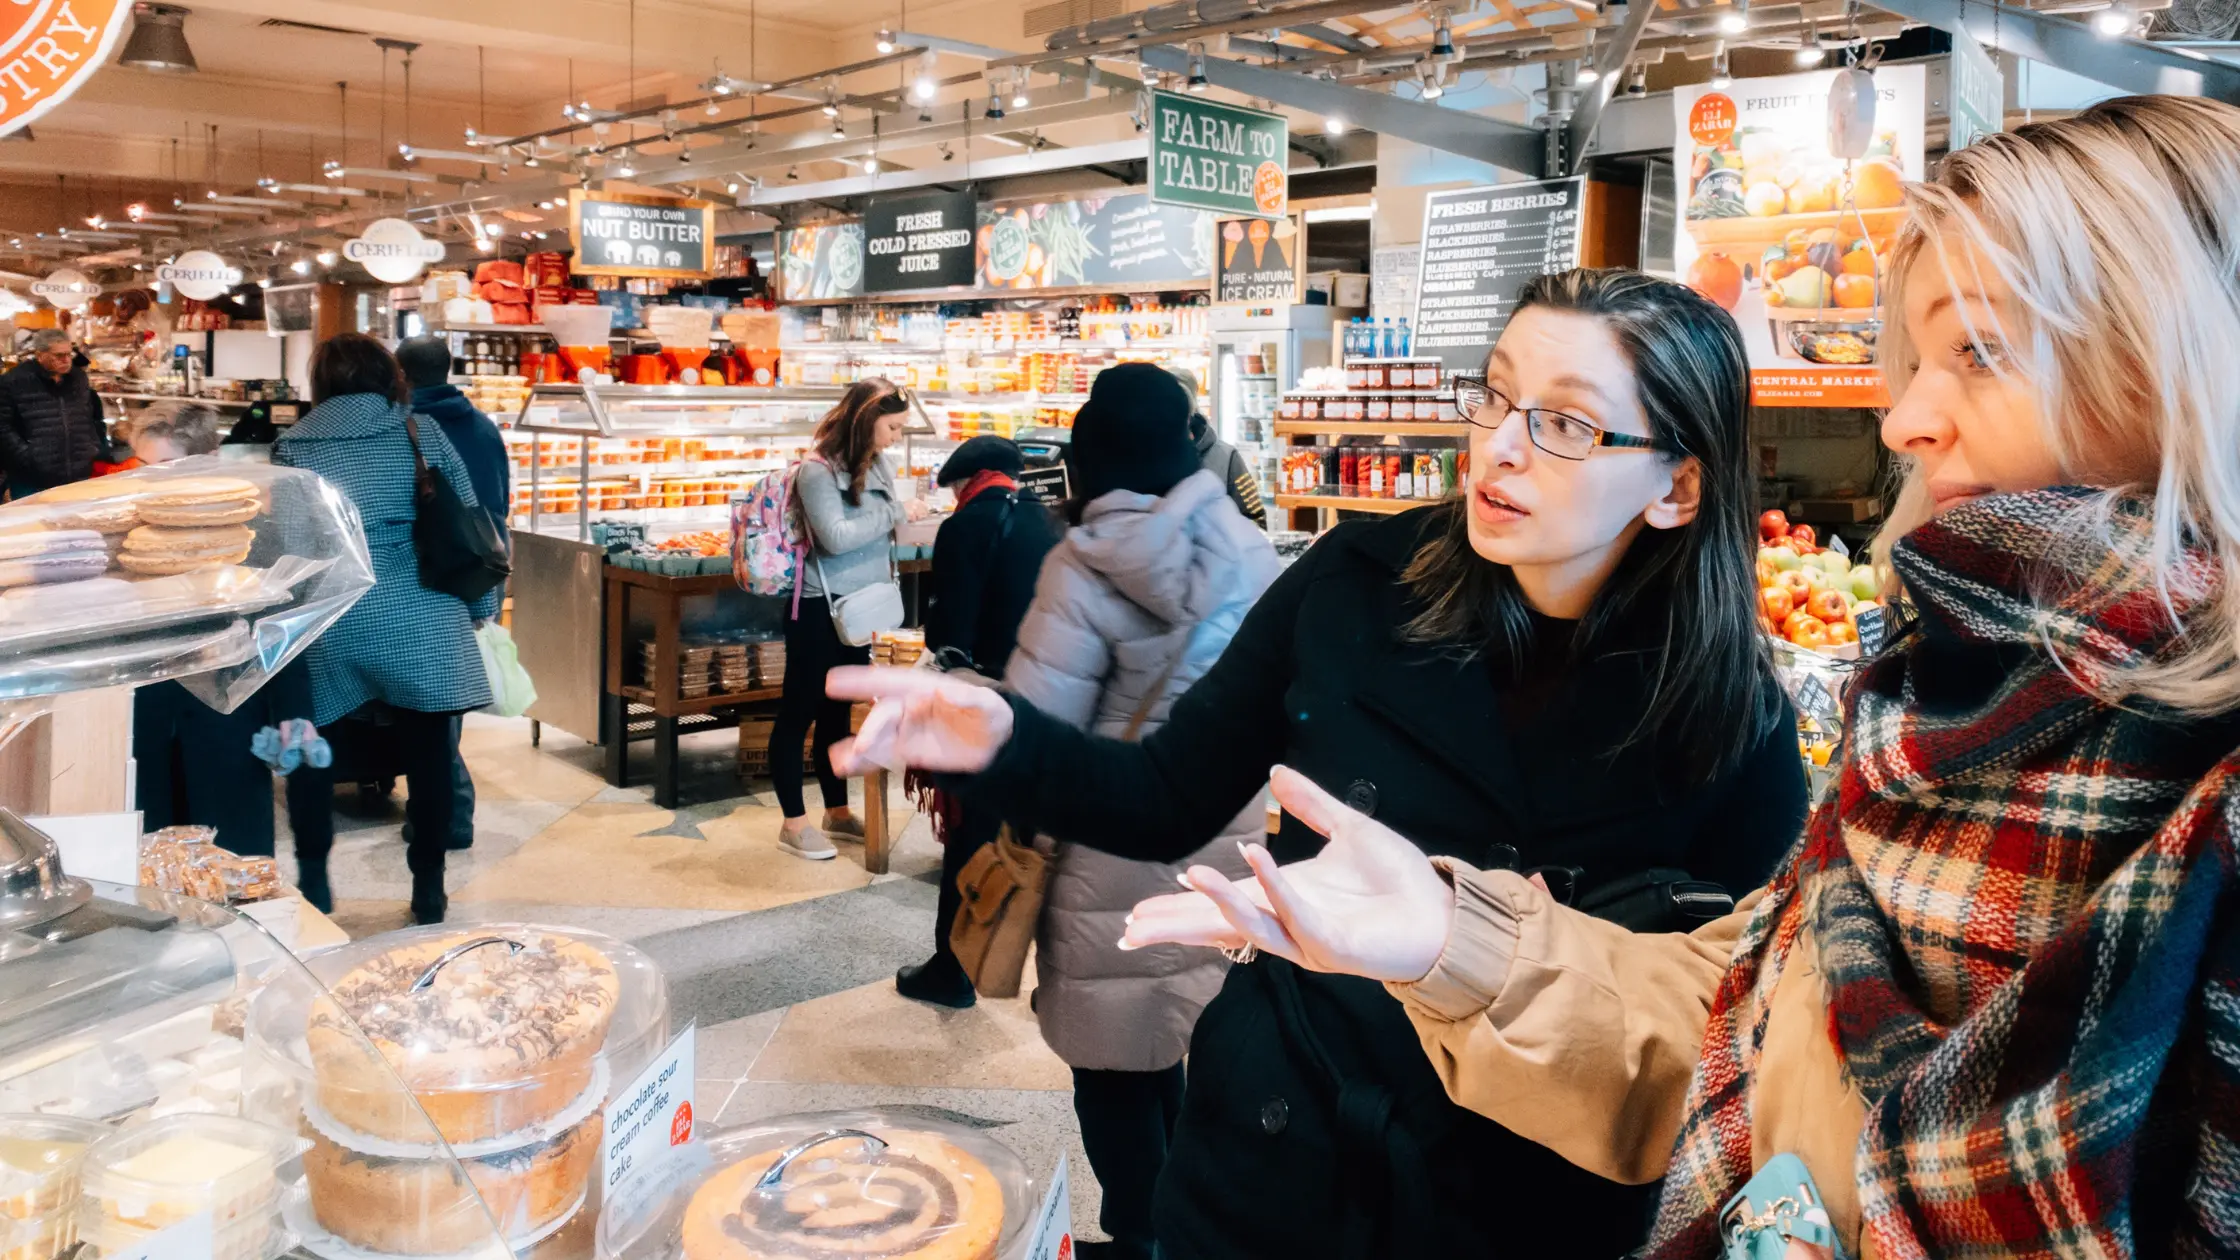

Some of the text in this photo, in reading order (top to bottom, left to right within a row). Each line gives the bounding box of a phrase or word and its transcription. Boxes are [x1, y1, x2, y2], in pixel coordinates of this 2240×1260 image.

[0, 0, 97, 115] TRY
[1161, 108, 1275, 158] FARM TO
[1160, 150, 1253, 198] TABLE
[633, 208, 660, 220] YOUR
[662, 210, 686, 221] OWN
[1432, 191, 1568, 219] FRESH BERRIES
[583, 218, 701, 243] NUT BUTTER
[896, 210, 943, 232] FRESH
[1429, 219, 1508, 236] STRAWBERRIES
[869, 229, 971, 255] COLD PRESSED
[1428, 233, 1505, 248] BLACKBERRIES
[898, 253, 940, 273] JUICE
[1427, 246, 1497, 261] RASPBERRIES
[1425, 259, 1496, 274] BLUEBERRIES
[1222, 270, 1294, 284] PURE NATURAL
[1222, 283, 1296, 302] ICE CREAM
[1421, 295, 1499, 309] STRAWBERRIES
[1420, 307, 1498, 321] BLACKBERRIES
[1419, 321, 1489, 335] RASPBERRIES
[1417, 335, 1487, 347] BLUEBERRIES
[1753, 375, 1882, 386] CENTRAL MARKET
[611, 1059, 679, 1134] chocolate sour
[610, 1091, 669, 1160] cream coffee
[609, 1154, 632, 1186] cake
